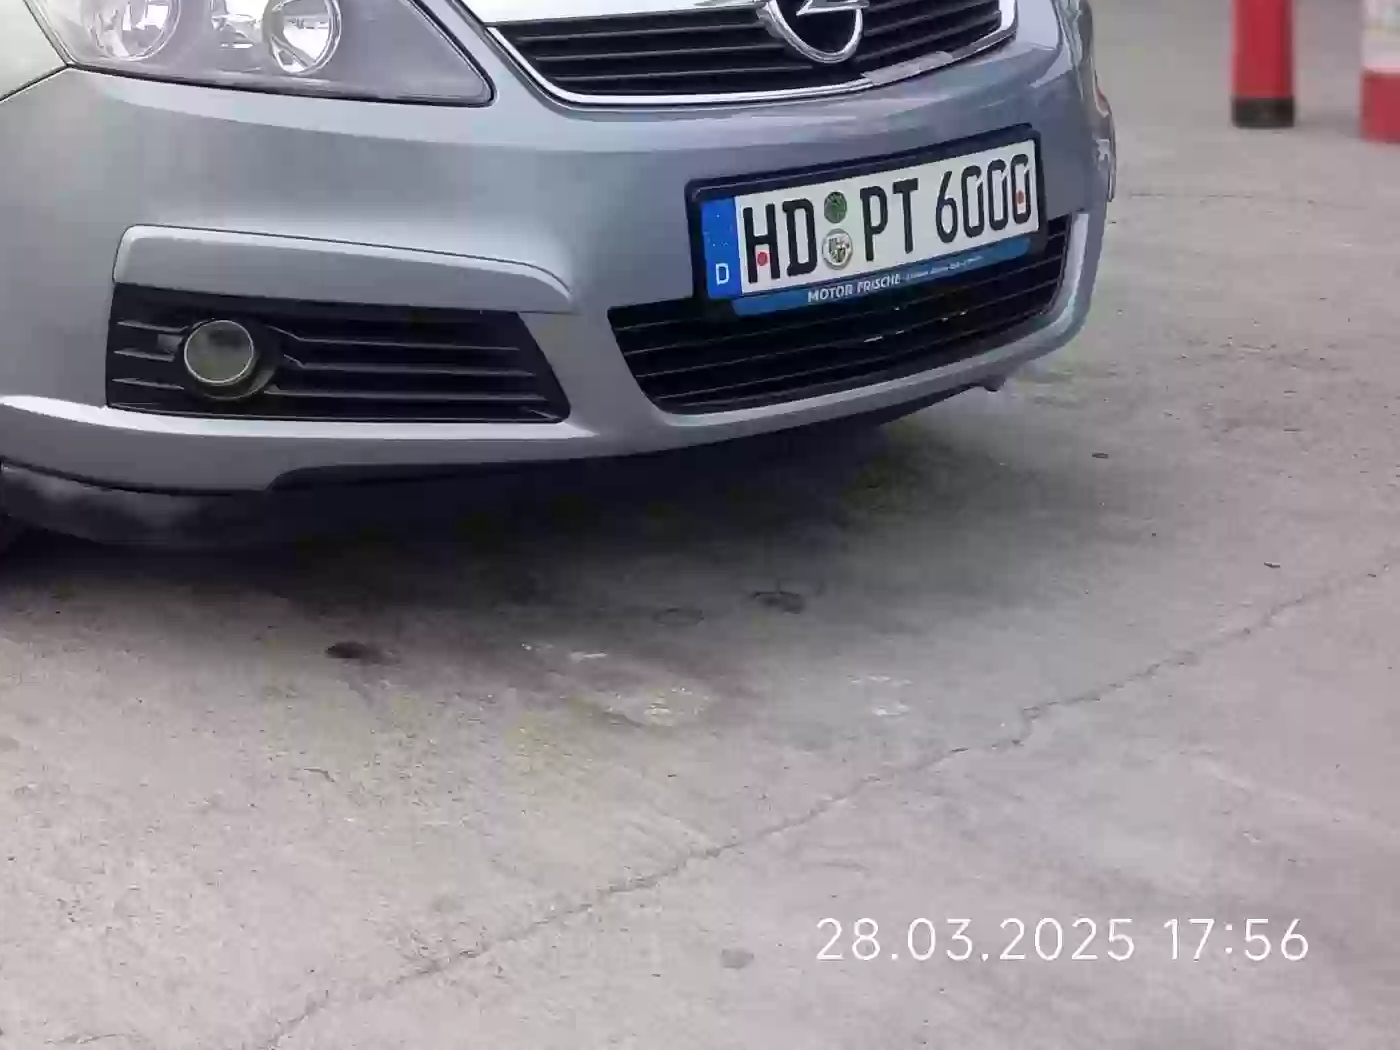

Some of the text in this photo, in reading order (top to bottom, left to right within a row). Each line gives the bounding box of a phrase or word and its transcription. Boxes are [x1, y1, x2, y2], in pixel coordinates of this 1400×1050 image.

[742, 153, 1033, 284] HD PT 6000
[715, 262, 730, 286] D
[807, 283, 854, 303] MOTOR
